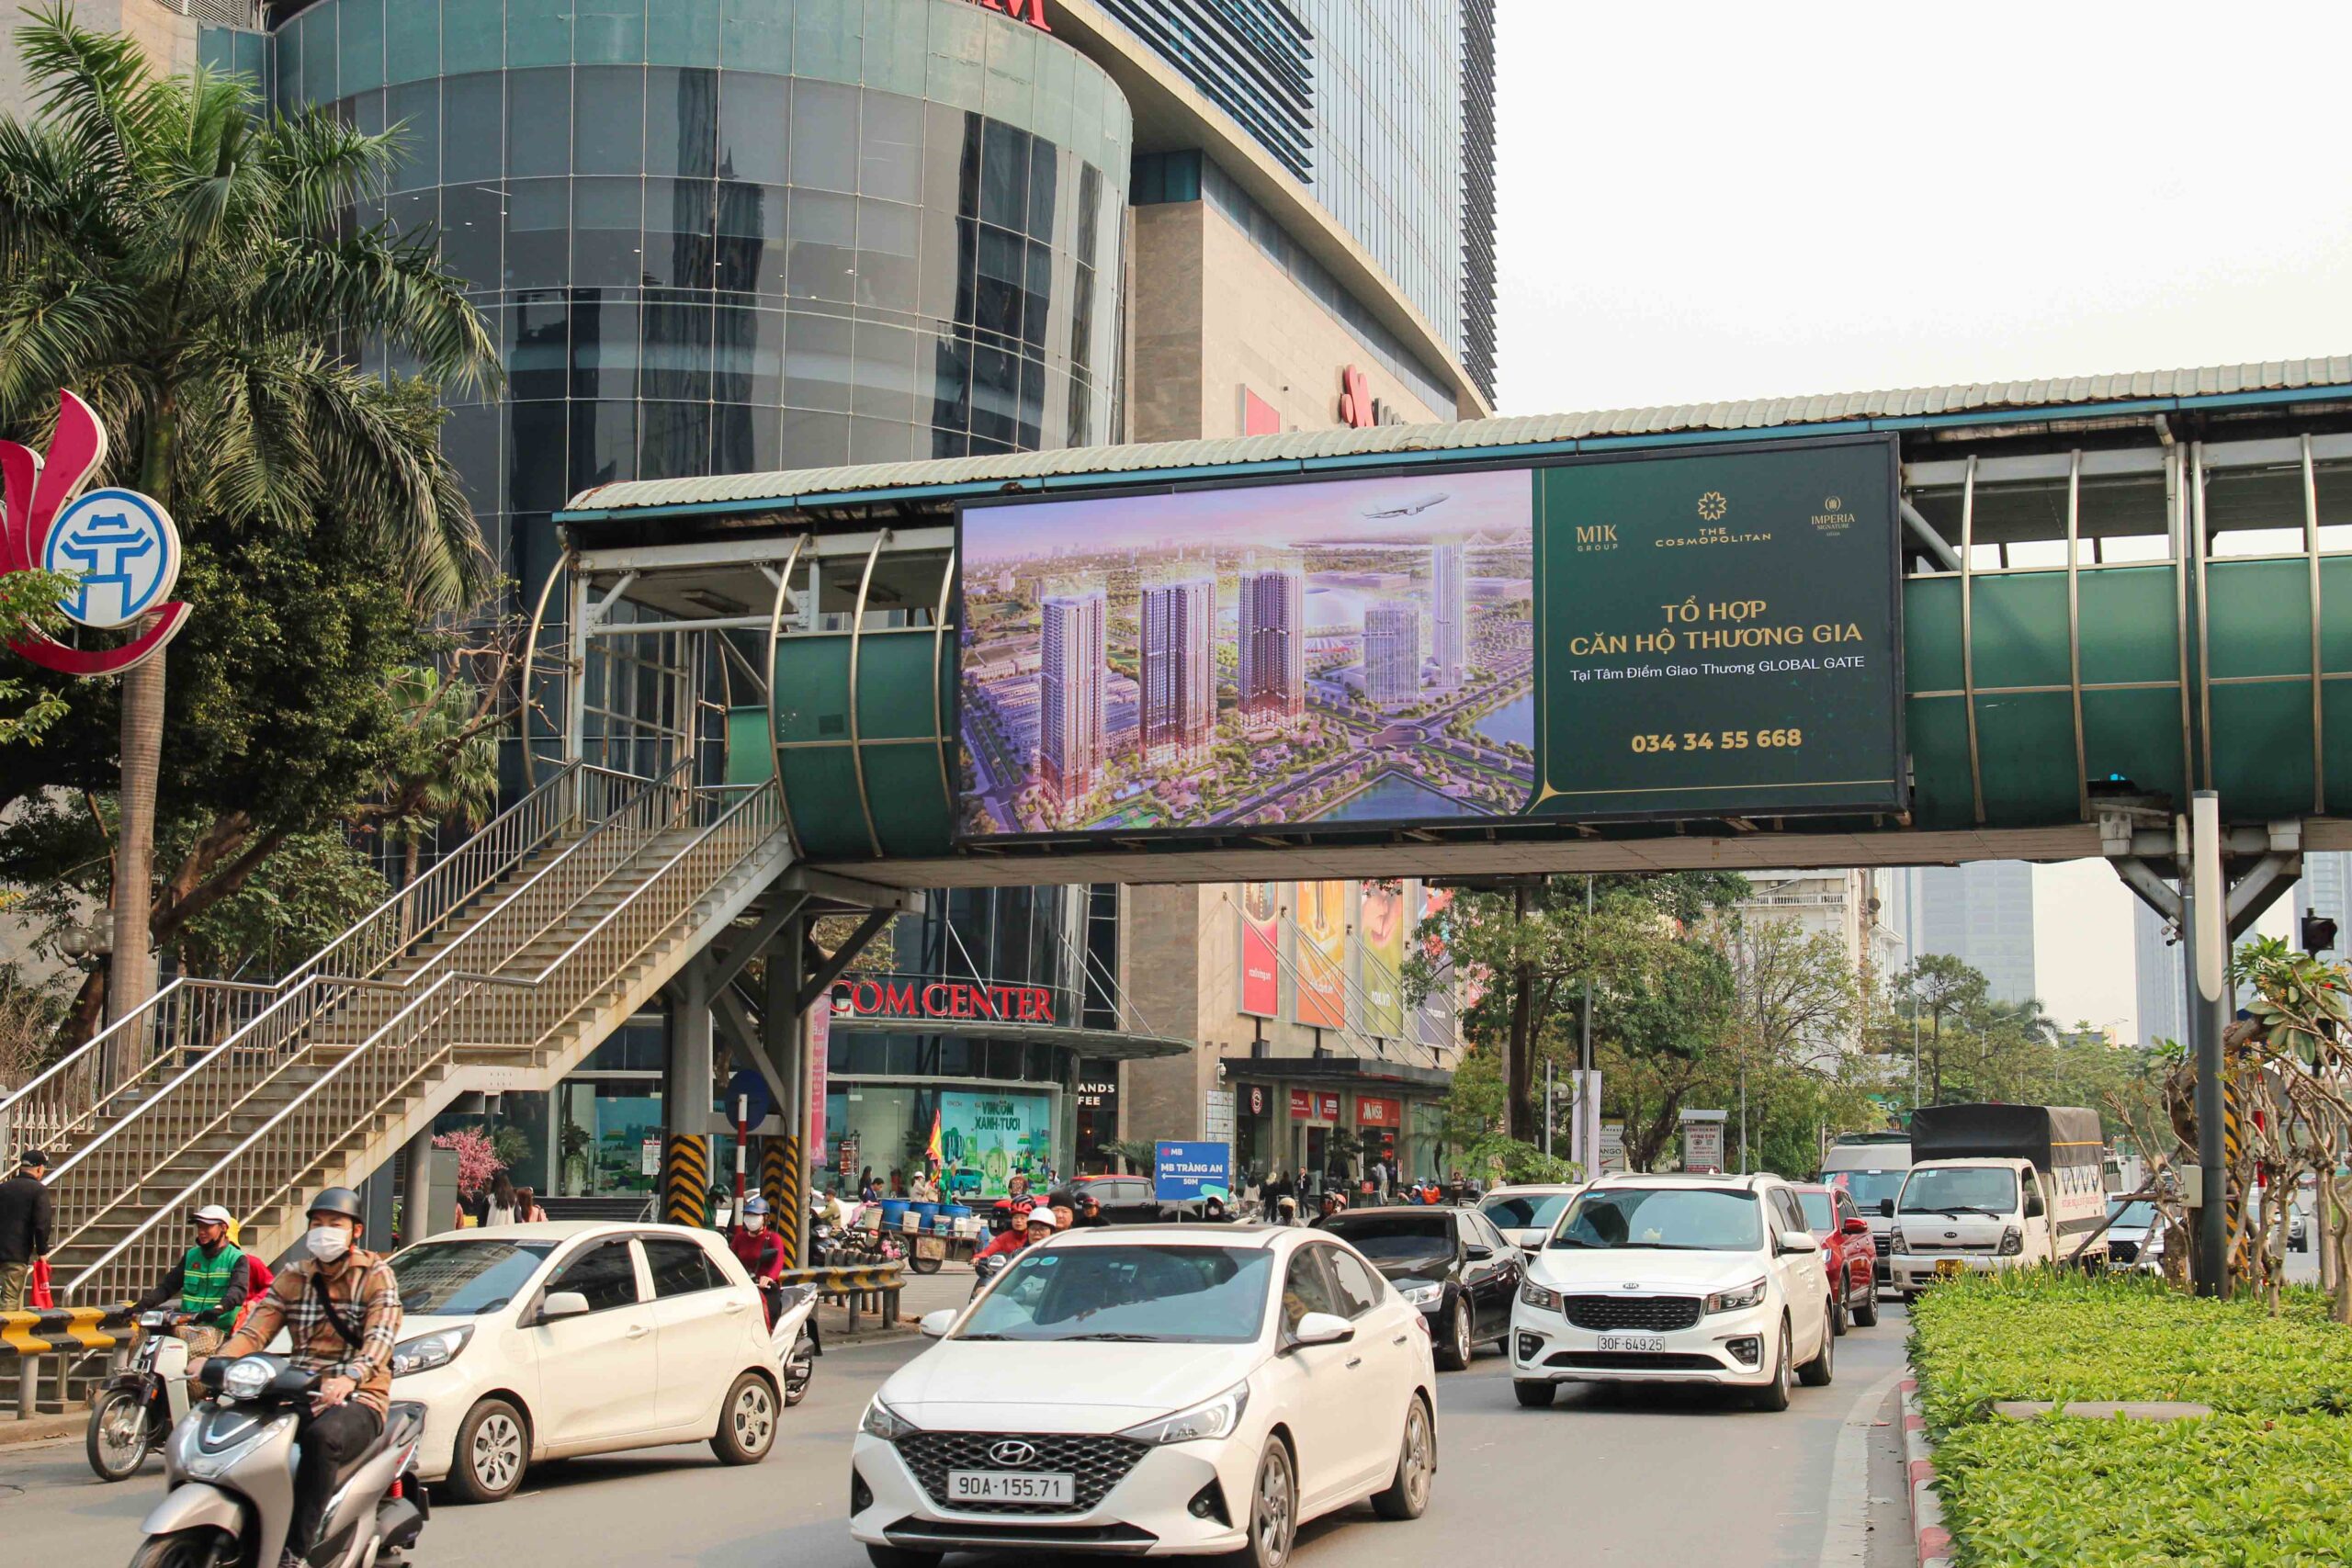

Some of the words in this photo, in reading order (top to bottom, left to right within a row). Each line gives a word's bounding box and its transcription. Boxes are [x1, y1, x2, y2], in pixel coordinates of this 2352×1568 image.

[1811, 513, 1855, 525] IMPERIA
[1576, 524, 1617, 543] MIK
[1700, 527, 1726, 536] THE
[1655, 533, 1771, 547] COSMOPOLITAN
[1577, 544, 1618, 552] GROUP
[1661, 595, 1700, 623] TỔ
[1709, 600, 1767, 623] HỢP
[1570, 632, 1627, 655] CĂN
[1635, 628, 1676, 654] HỘ
[1683, 626, 1804, 649] THƯƠNG
[1812, 623, 1863, 643] GIA
[1570, 670, 1590, 682] Tại
[1593, 668, 1623, 680] Tâm
[1627, 665, 1663, 679] Điểm
[1666, 665, 1698, 676] Giao
[1701, 662, 1756, 675] Thương
[1758, 659, 1821, 672] GLOBAL
[1824, 656, 1865, 670] GATE
[1632, 734, 1676, 753] 034
[1684, 733, 1713, 750] 34
[1721, 731, 1748, 750] 55
[1757, 729, 1802, 748] 668
[922, 983, 1056, 1021] CENTER
[982, 1101, 1014, 1116] VINCOM
[1371, 1105, 1383, 1120] MSB
[1160, 1163, 1175, 1172] MB
[1177, 1162, 1208, 1173] TRÀNG
[1209, 1164, 1223, 1173] AN
[1600, 1337, 1663, 1351] 30F-649.25
[958, 1477, 1060, 1498] 90A-155.71
